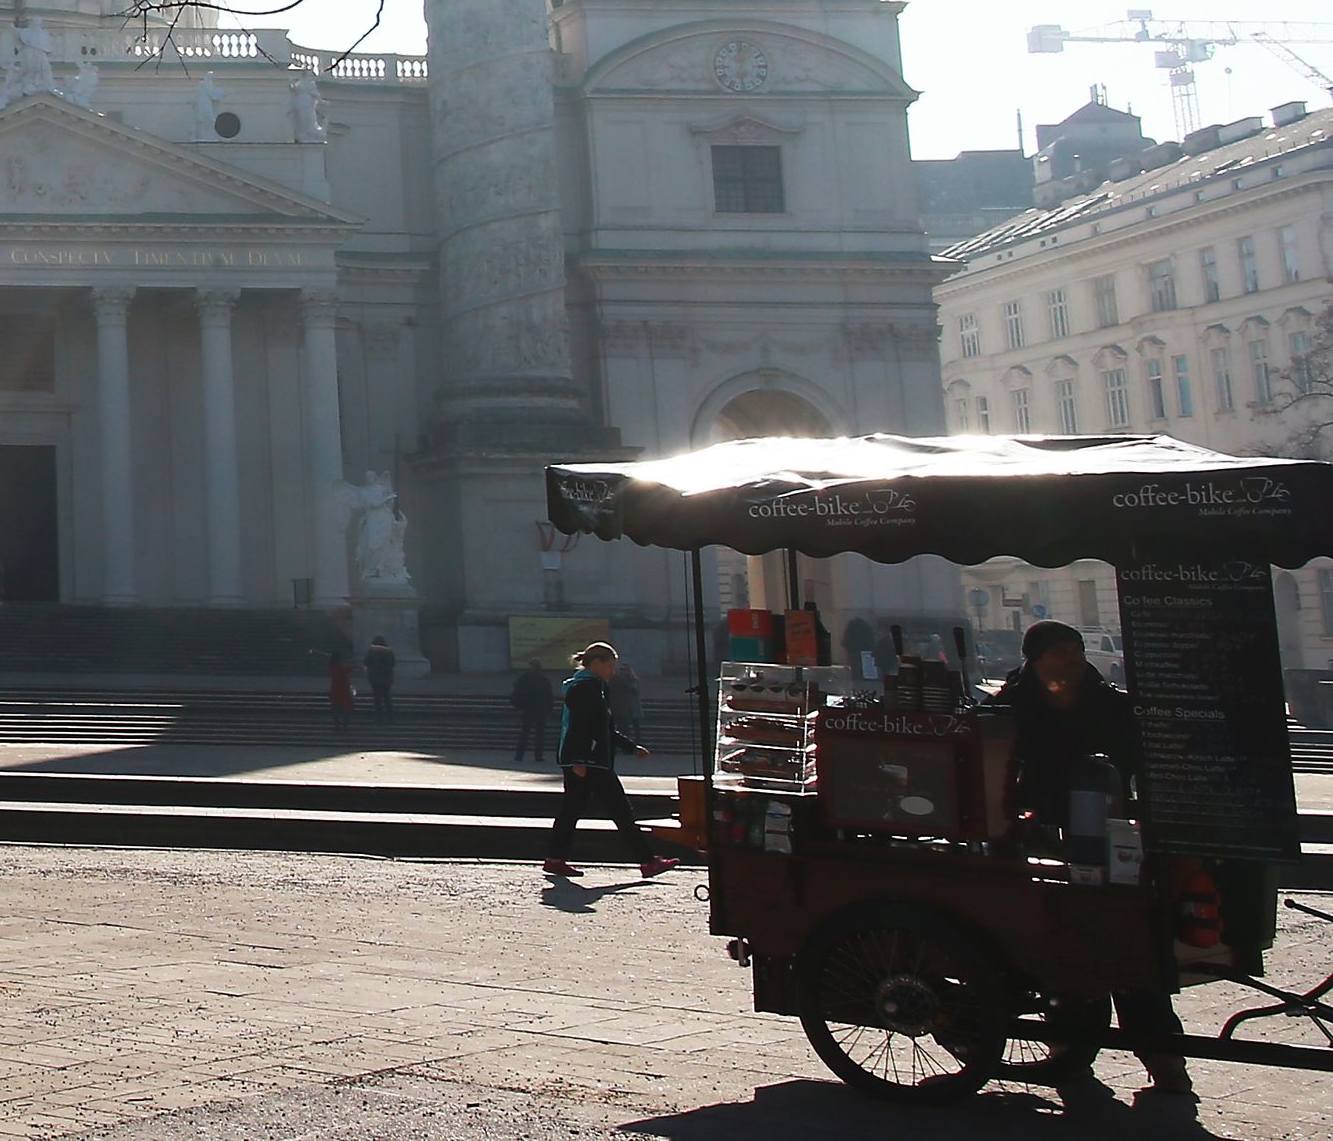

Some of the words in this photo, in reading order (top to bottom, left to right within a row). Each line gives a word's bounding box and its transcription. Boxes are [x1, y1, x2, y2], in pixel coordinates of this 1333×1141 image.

[1112, 482, 1235, 508] coffee-bike
[748, 494, 861, 518] coffee-bike
[1120, 563, 1219, 581] coffee-bike
[1123, 595, 1161, 606] Cofee
[1133, 705, 1172, 718] Coffee
[1174, 706, 1226, 721] Specials
[824, 712, 924, 735] coffee-bike
